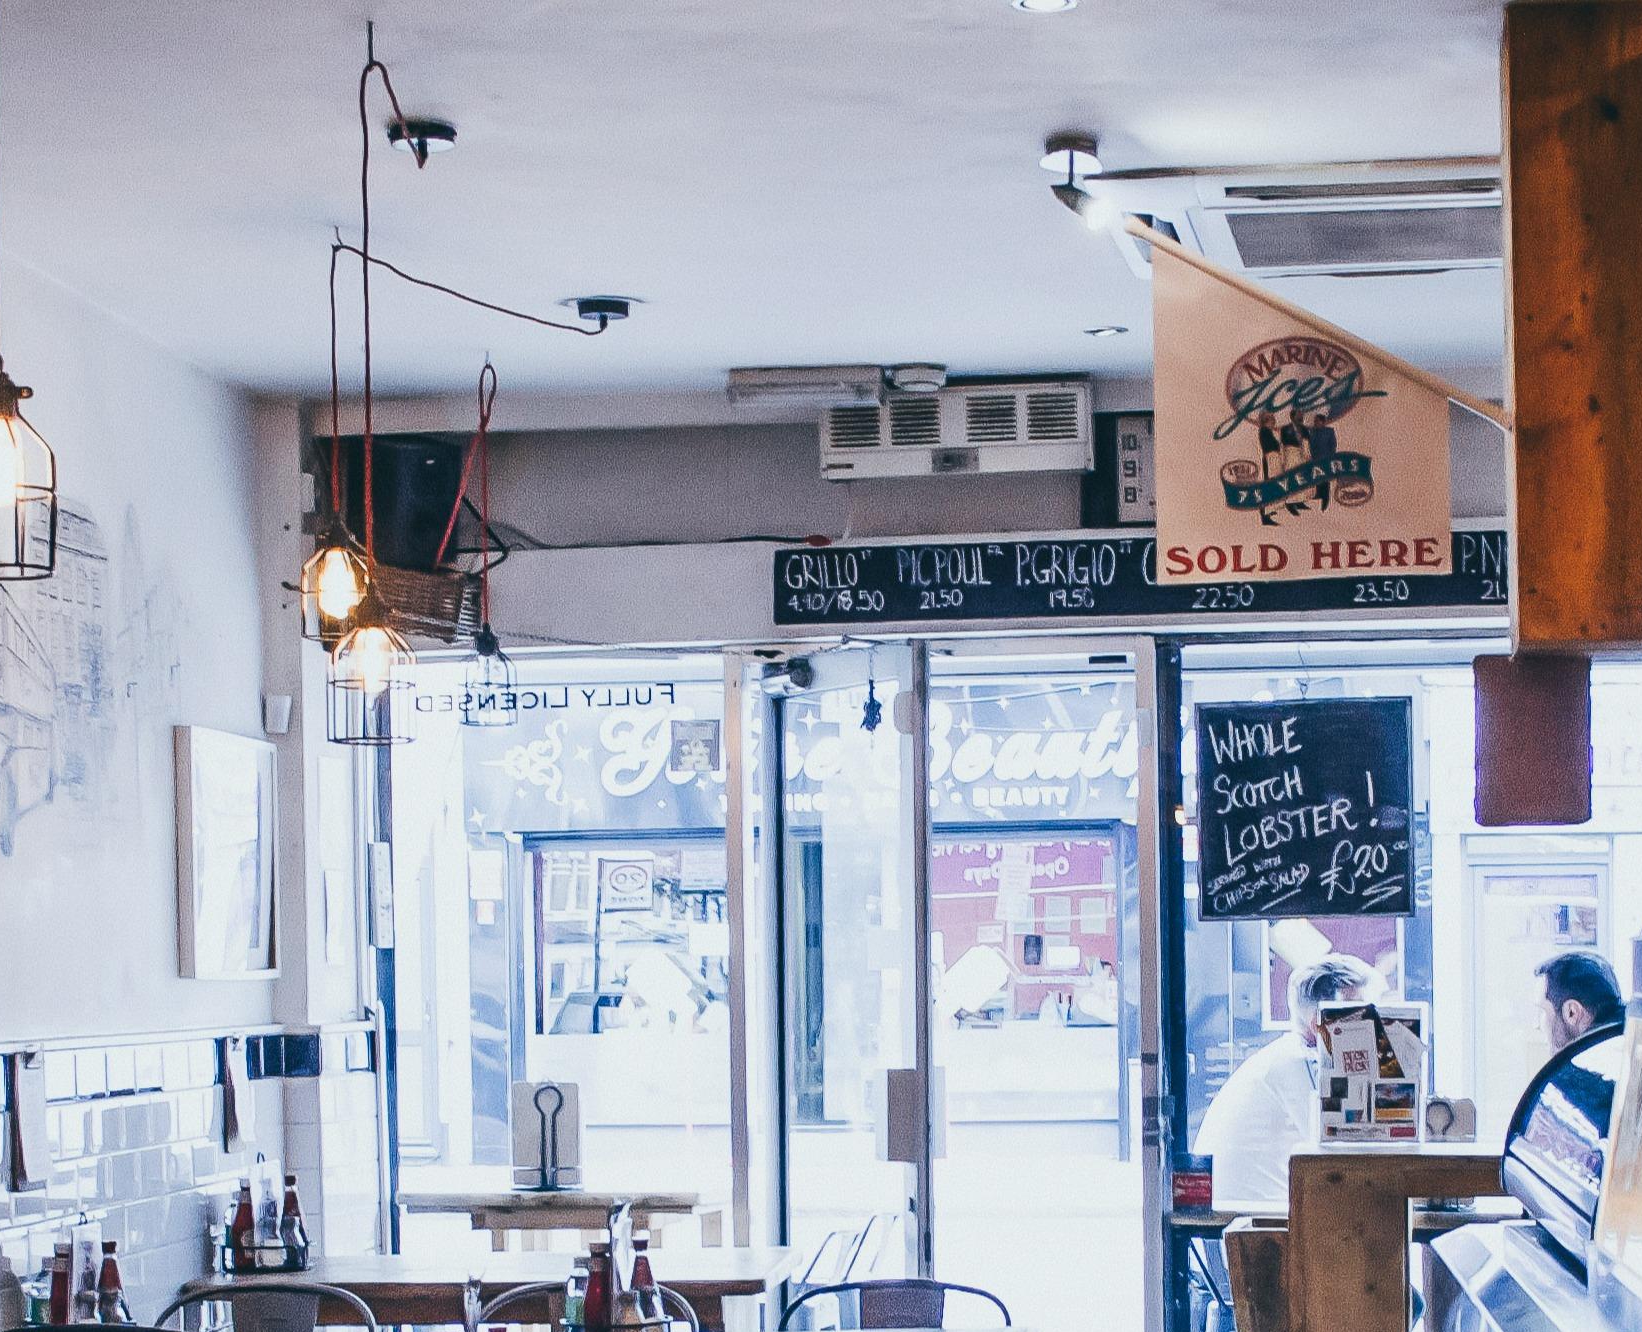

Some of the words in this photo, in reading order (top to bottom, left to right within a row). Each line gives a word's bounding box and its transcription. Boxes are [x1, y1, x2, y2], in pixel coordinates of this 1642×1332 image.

[1243, 343, 1344, 384] MARINE
[1278, 458, 1359, 494] YEARS
[785, 553, 858, 589] GRILLO
[896, 545, 992, 587] PICPOUL
[1016, 542, 1116, 588] P.GRIGIO
[1165, 544, 1289, 577] SOLD
[1311, 537, 1443, 570] HERE
[920, 589, 964, 610] 21.50
[1193, 587, 1255, 609] 22.50
[1353, 579, 1410, 604] 23.50
[1208, 716, 1303, 764] WHOLE
[972, 786, 1069, 808] BEAUTY
[1213, 766, 1304, 815] SCOTCH
[1223, 798, 1359, 868] LOBSTER
